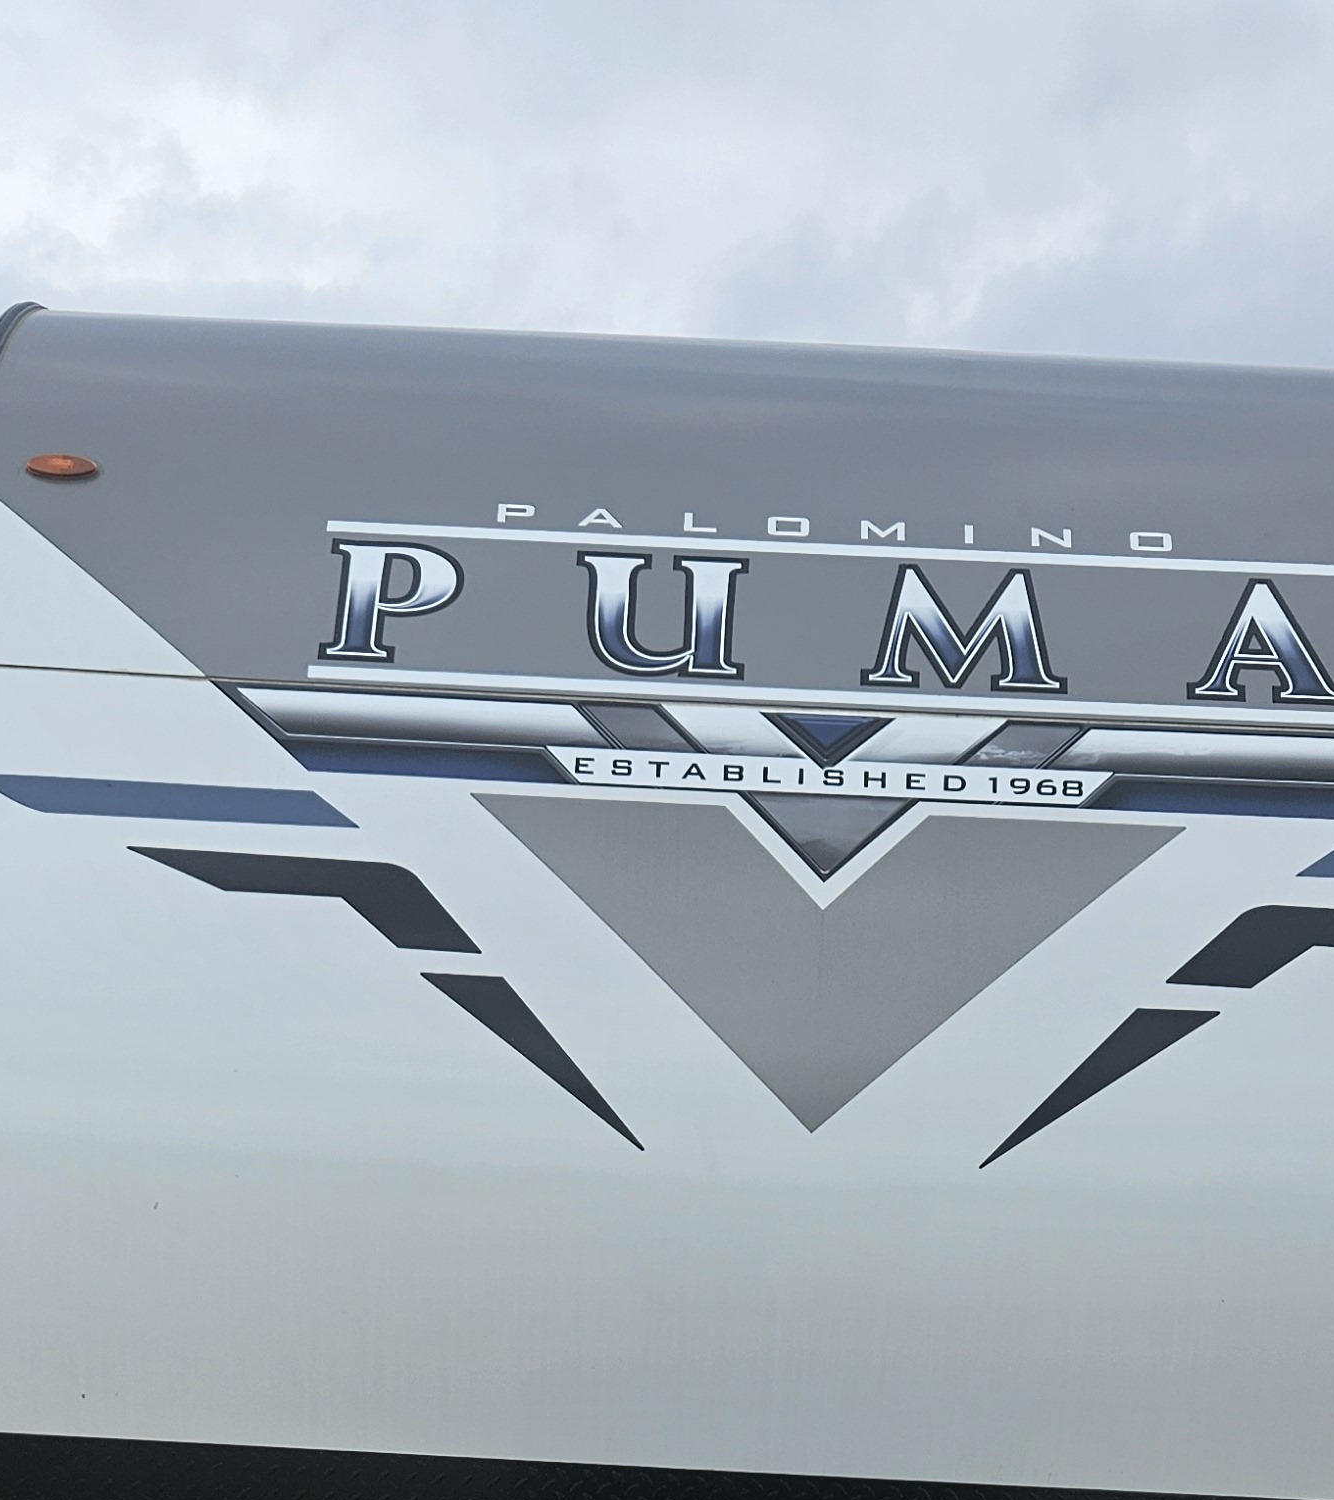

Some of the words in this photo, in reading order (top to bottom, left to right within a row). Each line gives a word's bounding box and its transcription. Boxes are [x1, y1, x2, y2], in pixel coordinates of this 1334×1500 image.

[496, 502, 1173, 552] PALOMINO
[573, 756, 968, 792] ESTABLISHED
[988, 775, 1084, 798] 1968
